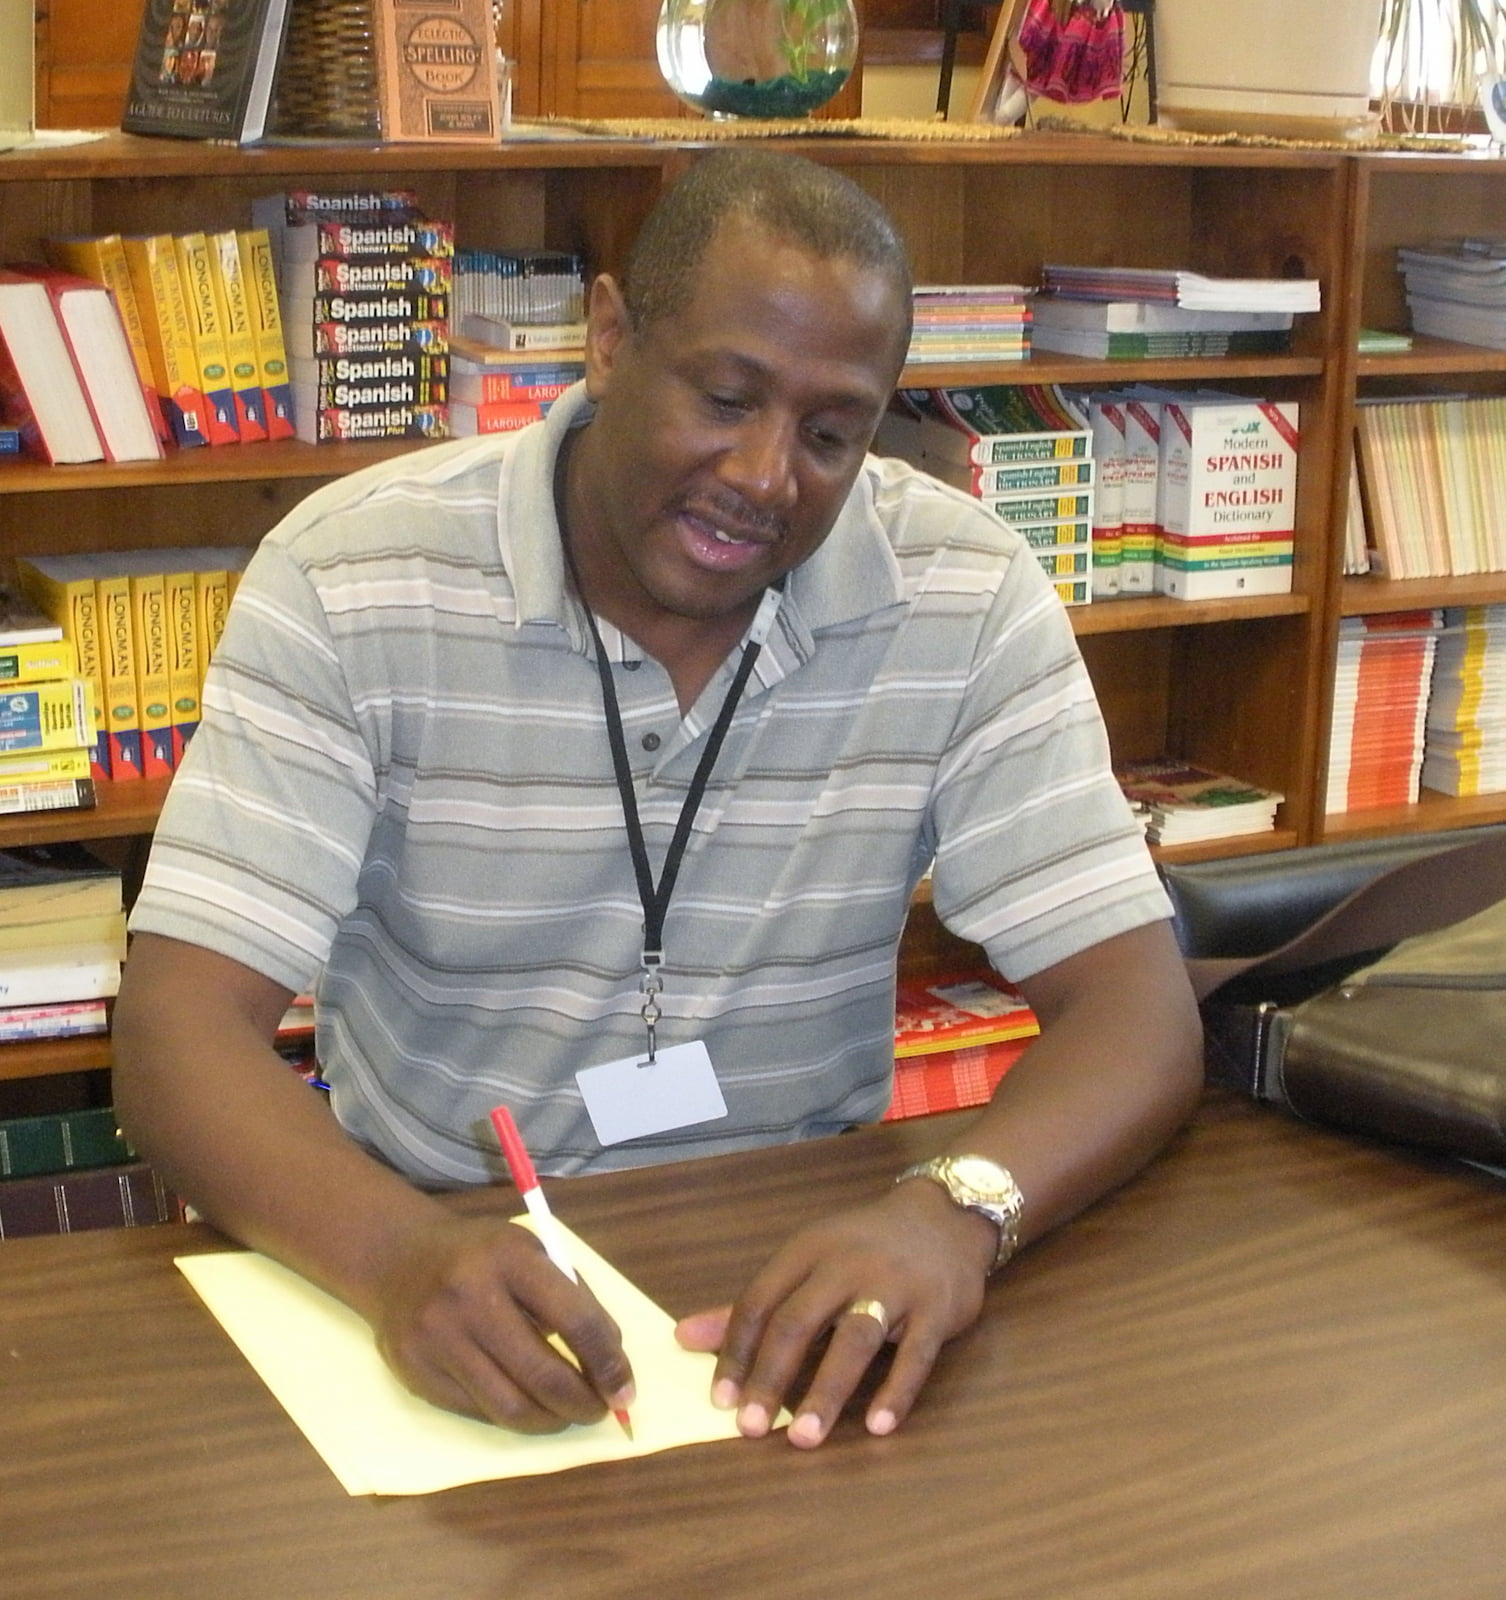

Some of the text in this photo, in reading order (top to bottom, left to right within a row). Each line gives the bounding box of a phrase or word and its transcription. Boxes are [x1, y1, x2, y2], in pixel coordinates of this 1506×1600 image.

[407, 46, 476, 64] SPELLING
[305, 194, 381, 210] Spanish
[338, 225, 416, 249] Spanish
[342, 244, 409, 254] Dictionary Plus
[336, 261, 413, 285] Spanish
[193, 247, 217, 333] LONGMAN
[257, 245, 277, 330] LONGMAN
[340, 281, 406, 292] Dictionary Plus
[331, 295, 412, 322] Spanish
[335, 322, 411, 344] Spanish
[338, 342, 404, 353] Dictionary Plus
[336, 356, 414, 383] Spanish
[335, 382, 413, 408] Spanish
[338, 407, 413, 430] Spanish
[341, 426, 405, 438] Dictionary Plus
[1223, 437, 1269, 450] Modern
[1207, 454, 1283, 472] SPANISH
[1233, 473, 1256, 485] and
[1204, 488, 1283, 508] ENGLISH
[1213, 509, 1273, 523] Dictionary
[79, 593, 97, 678] LONGMAN
[113, 594, 130, 677] LONGMAN
[148, 592, 163, 675] LONGMAN
[178, 586, 194, 669] LONGMAN
